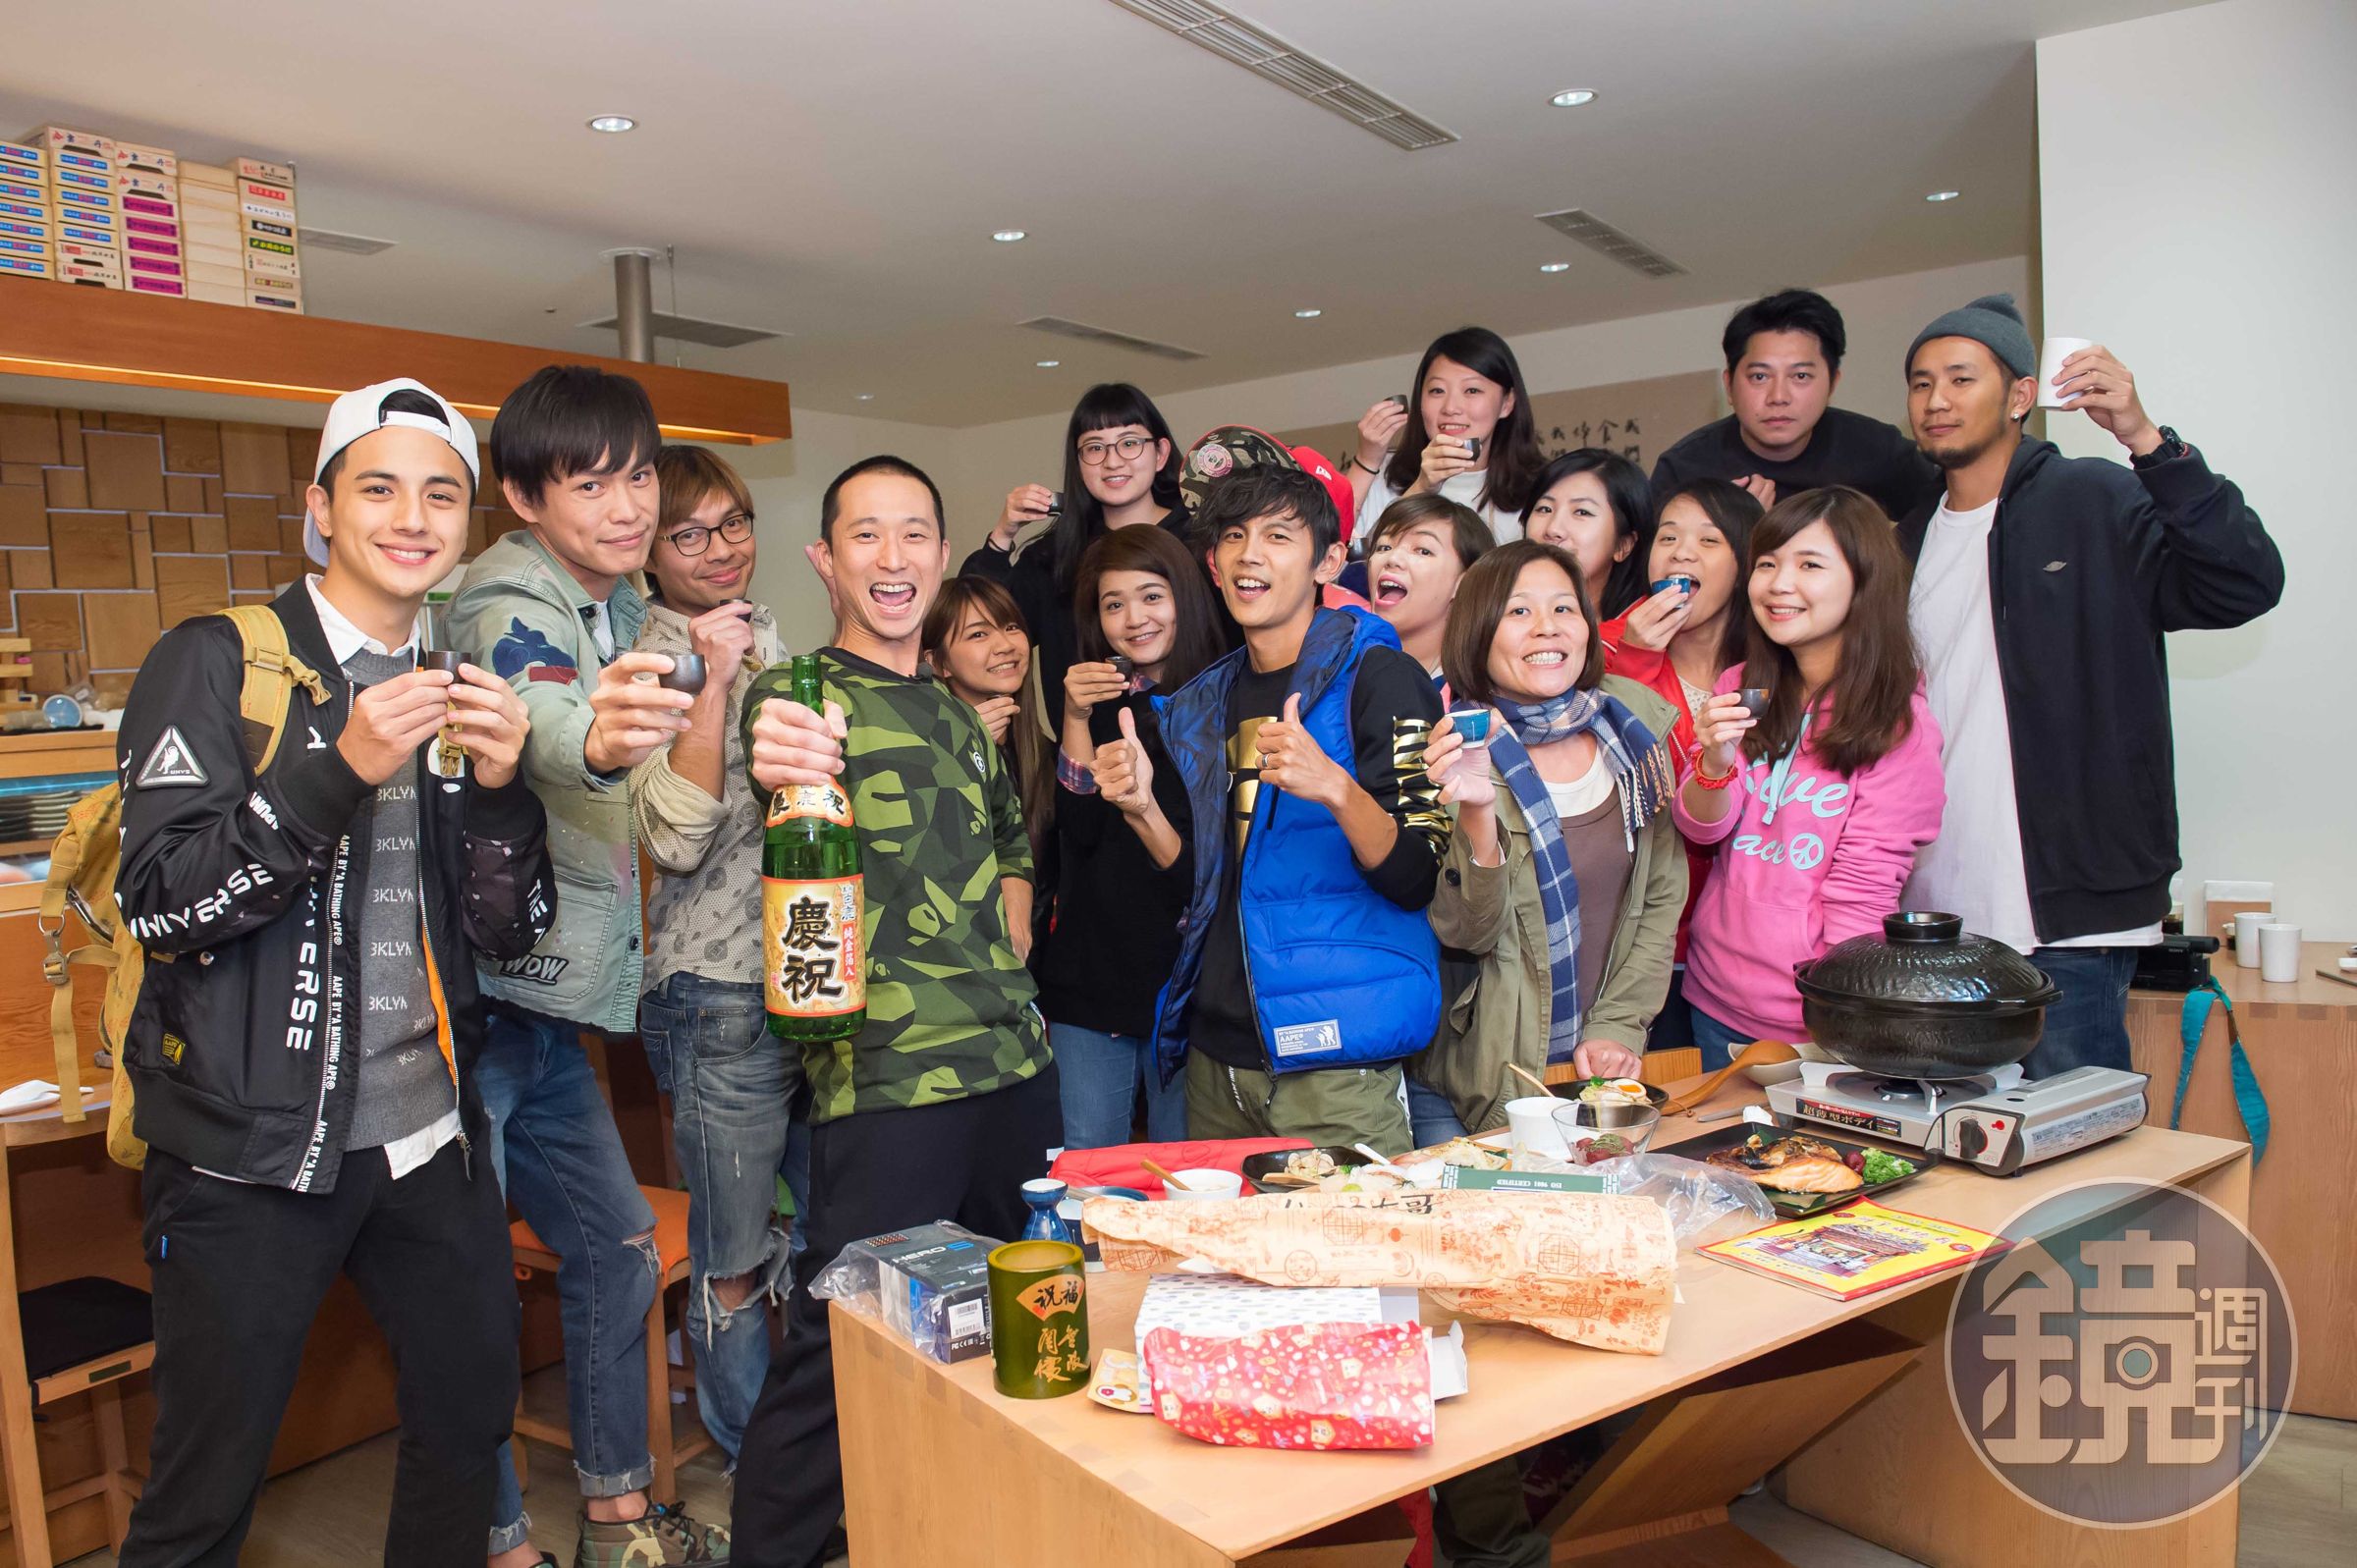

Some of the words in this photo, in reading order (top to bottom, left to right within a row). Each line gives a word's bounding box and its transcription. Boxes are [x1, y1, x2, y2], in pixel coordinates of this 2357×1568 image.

[337, 859, 349, 871] BY
[331, 883, 344, 919] BATHING
[782, 894, 843, 1004] 慶祝
[844, 926, 855, 977] 純金箔入
[332, 976, 344, 999] AAPE
[331, 1001, 343, 1012] BY
[328, 1026, 342, 1063] BATHING
[312, 1119, 328, 1144] AAPE
[309, 1146, 322, 1159] BY
[1033, 1280, 1079, 1310] 祝福
